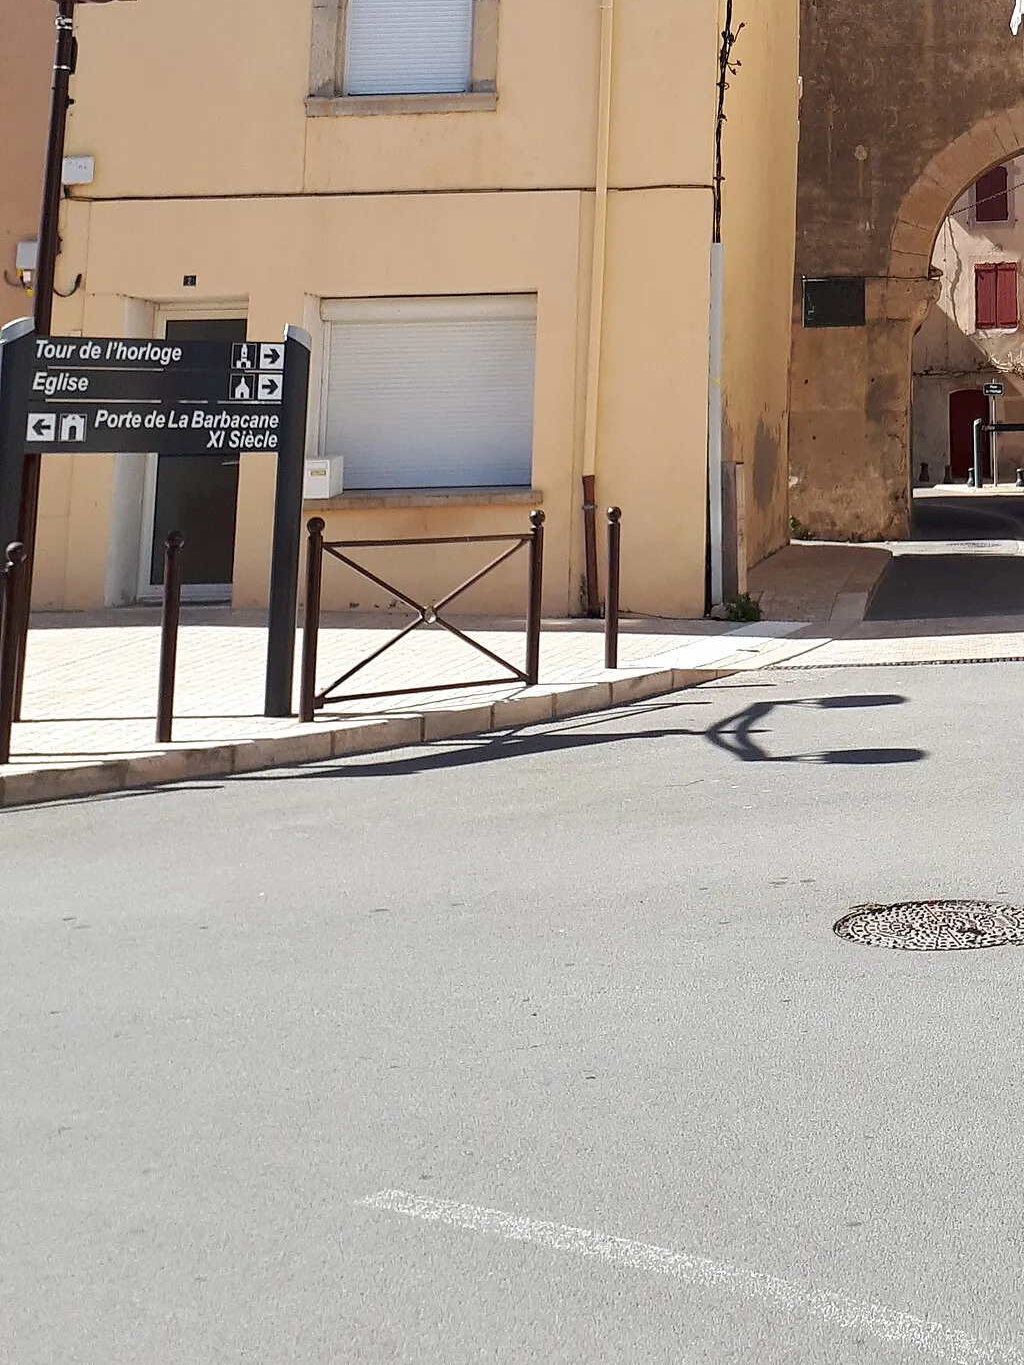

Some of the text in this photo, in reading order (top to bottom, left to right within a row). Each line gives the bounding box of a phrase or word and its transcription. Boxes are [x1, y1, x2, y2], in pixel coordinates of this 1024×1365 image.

[36, 339, 182, 366] Tour de l'horloge
[32, 371, 89, 395] Eglise
[94, 409, 279, 429] Porte de La Barbacane
[206, 430, 278, 448] XI Siècle
